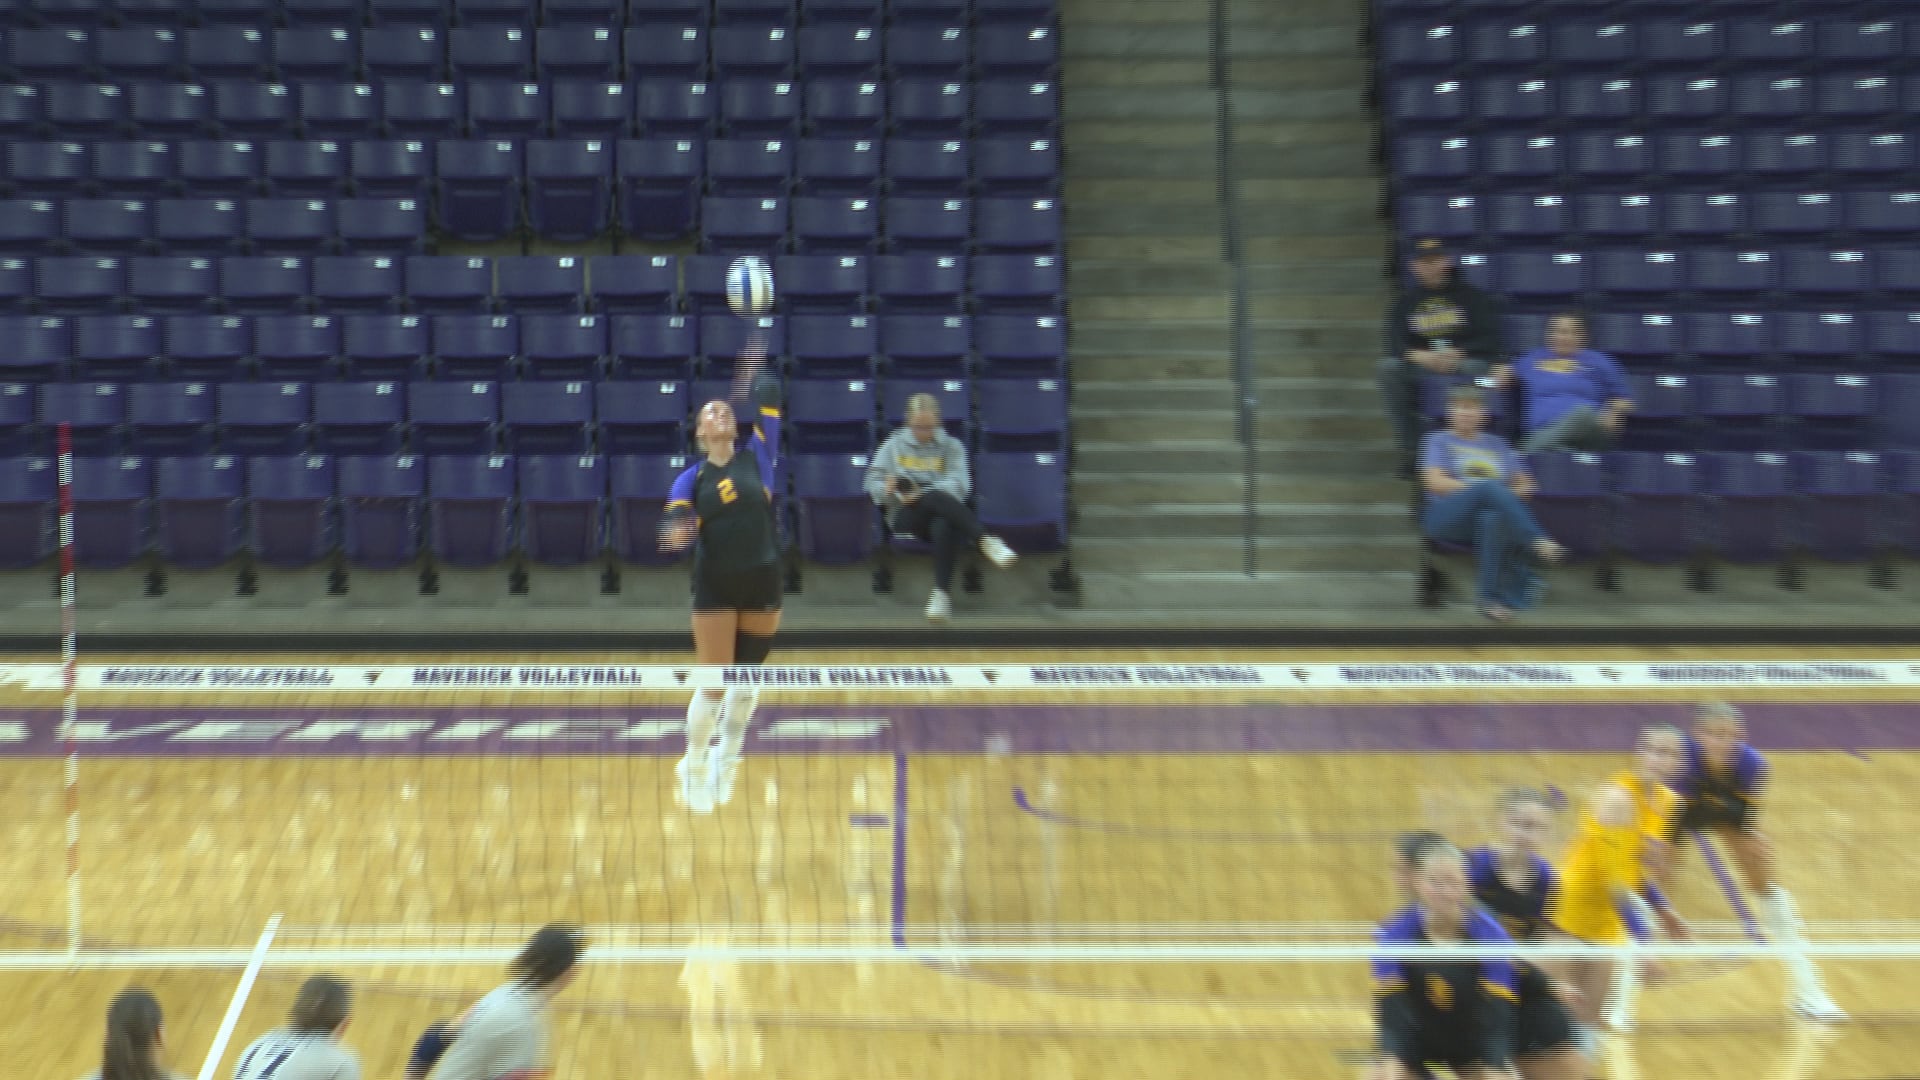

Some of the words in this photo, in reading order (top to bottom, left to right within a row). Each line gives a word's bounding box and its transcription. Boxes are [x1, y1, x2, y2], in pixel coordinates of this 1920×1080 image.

[717, 477, 738, 504] 2
[101, 667, 203, 686] MAVERICK
[208, 667, 333, 686] VOLLEYBALL
[412, 668, 512, 685] MAVERICK
[518, 668, 642, 685] VOLLEYBALL
[723, 667, 822, 685] MAVERICK
[828, 667, 953, 685] VOLLEYBALL
